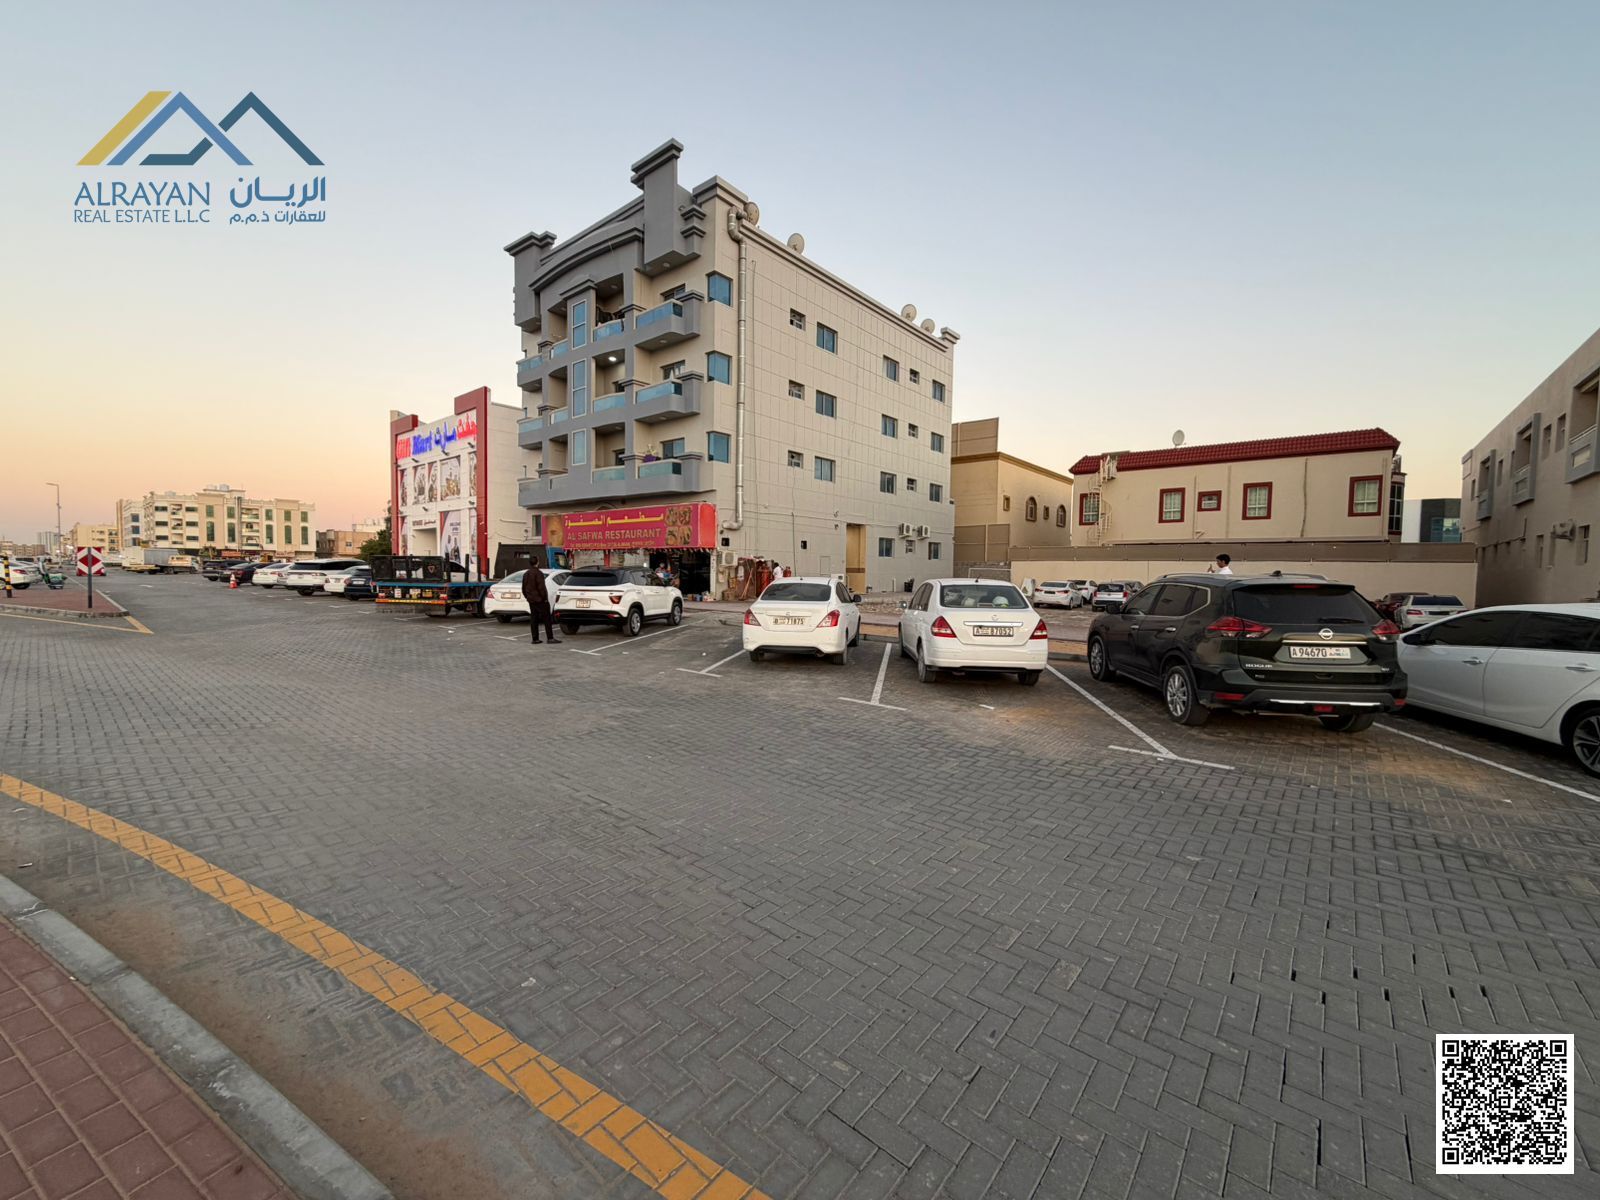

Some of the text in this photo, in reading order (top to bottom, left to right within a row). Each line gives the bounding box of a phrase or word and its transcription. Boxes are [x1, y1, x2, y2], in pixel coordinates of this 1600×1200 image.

[412, 430, 433, 455] Mart
[606, 511, 664, 527] مطعم
[567, 528, 661, 541] AL SAFWA RESTAURANT
[1292, 648, 1298, 657] A
[1299, 647, 1327, 658] 94670
